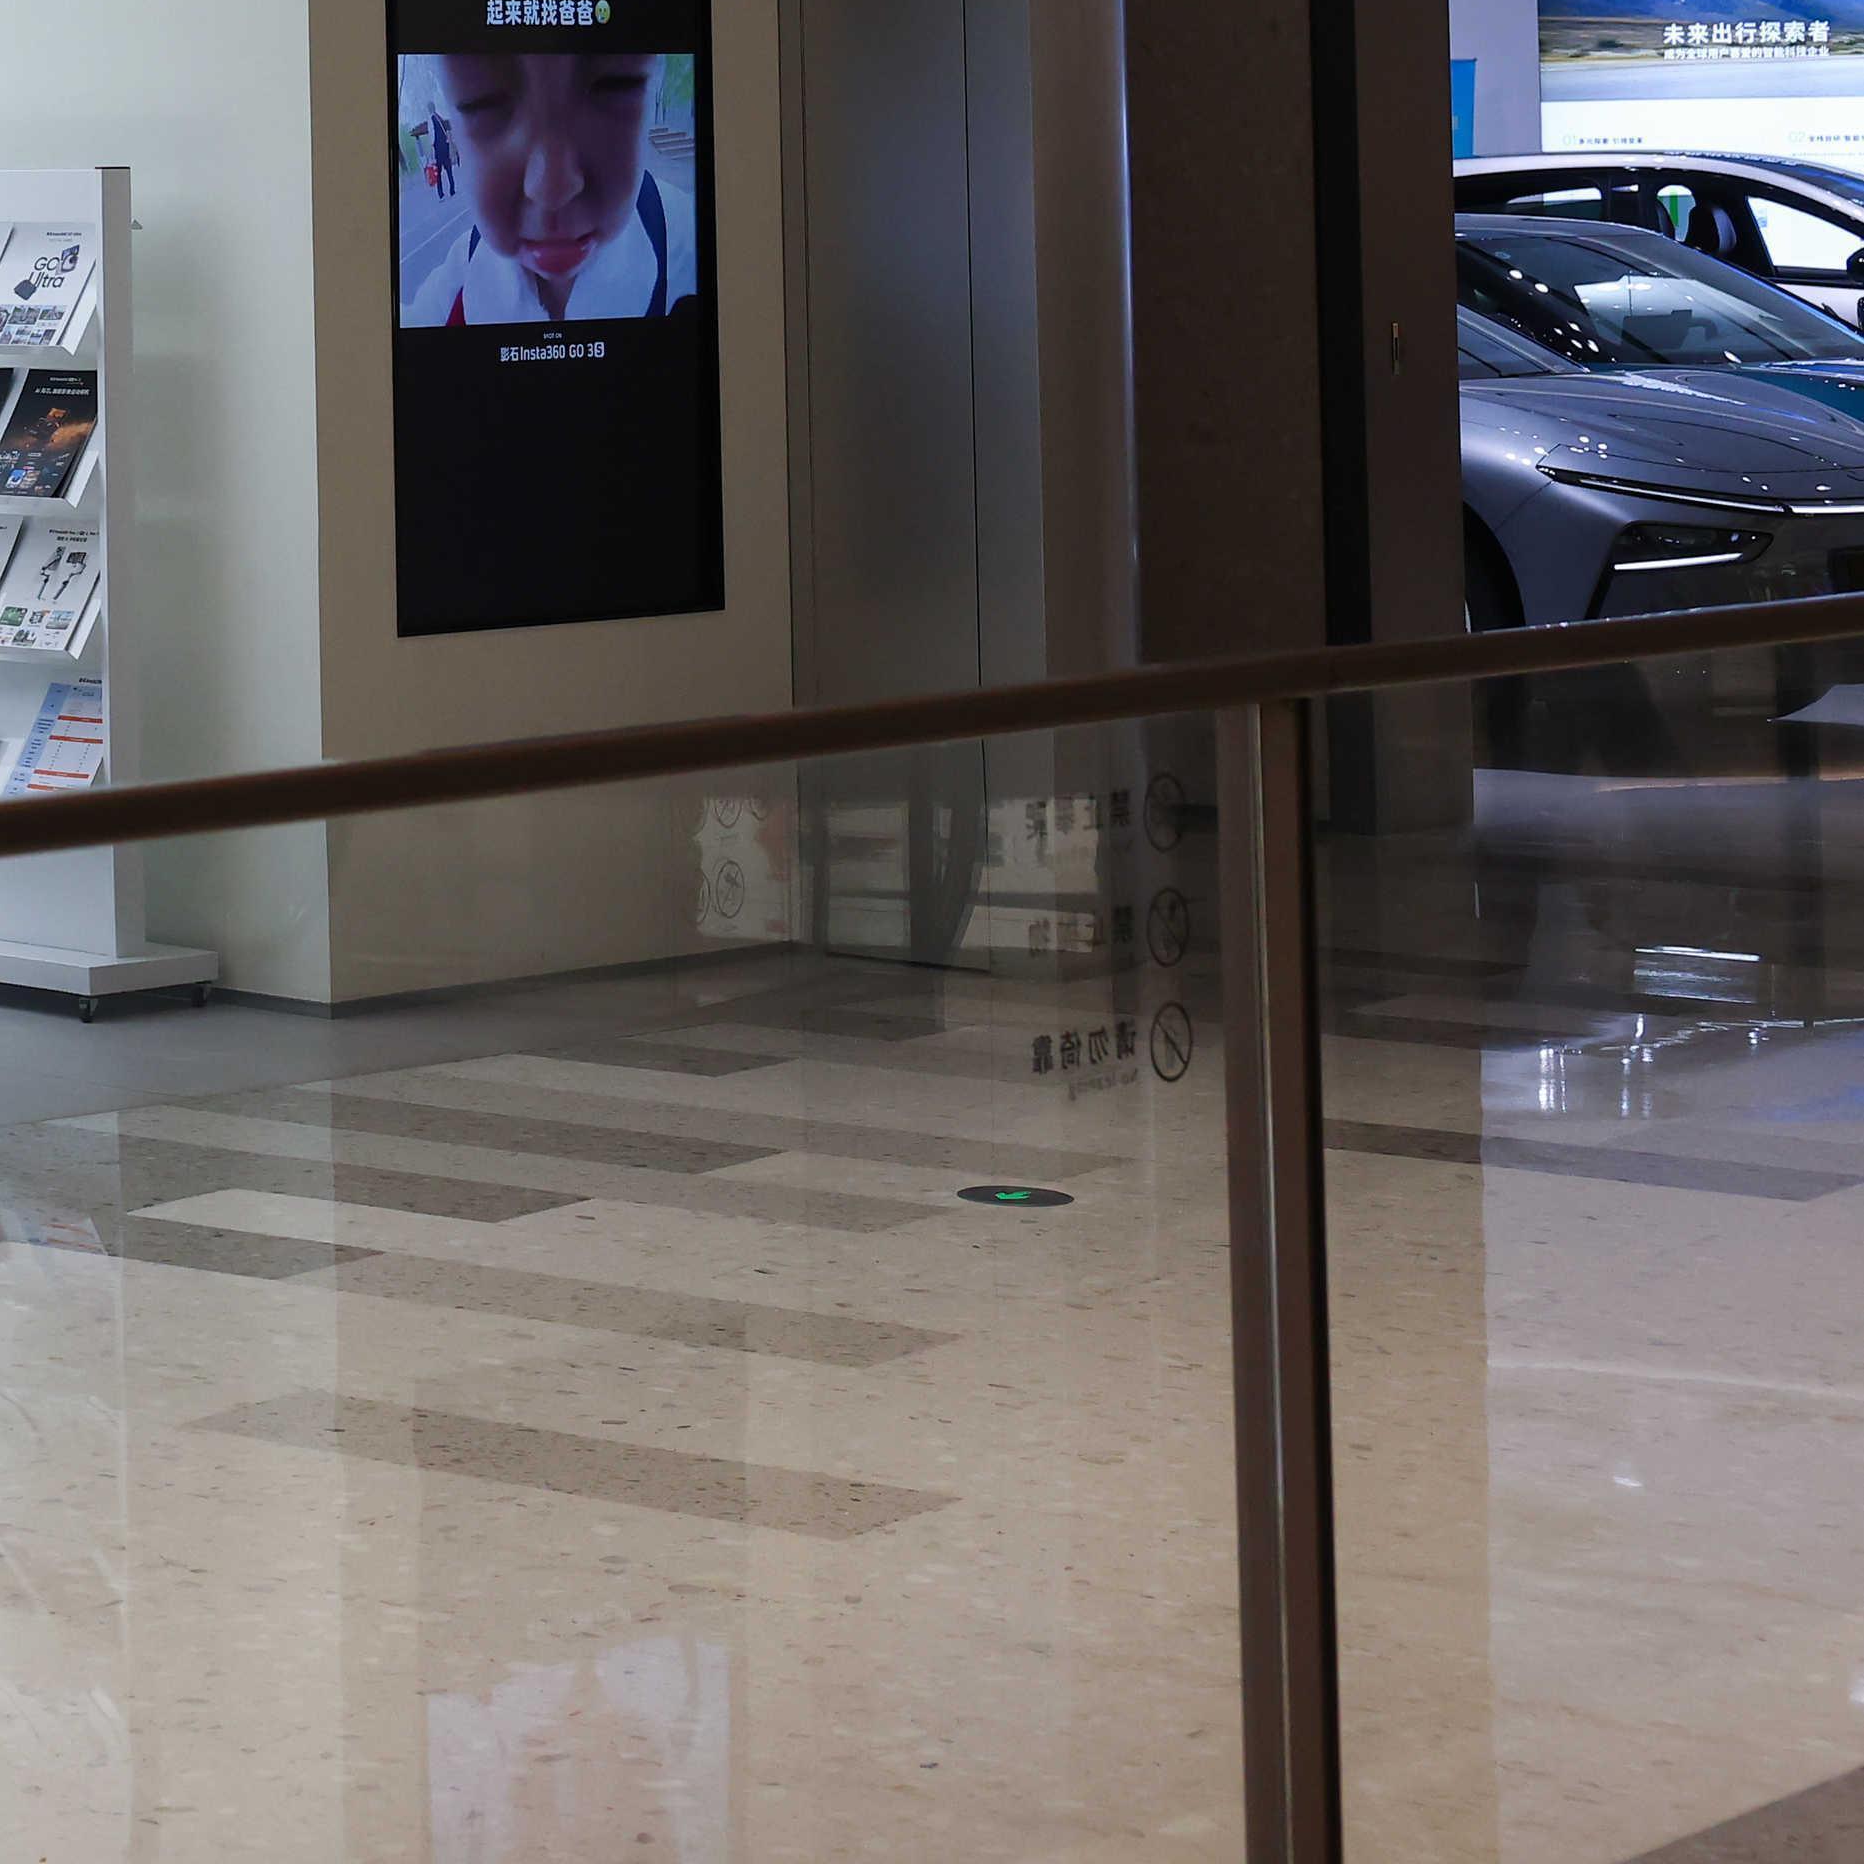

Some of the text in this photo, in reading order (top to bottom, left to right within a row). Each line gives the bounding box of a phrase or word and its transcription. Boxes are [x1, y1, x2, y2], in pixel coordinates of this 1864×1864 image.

[1663, 20, 1831, 46] 未来出行探索者
[500, 347, 519, 362] 影石
[520, 345, 566, 361] Insta360
[569, 344, 584, 358] GO
